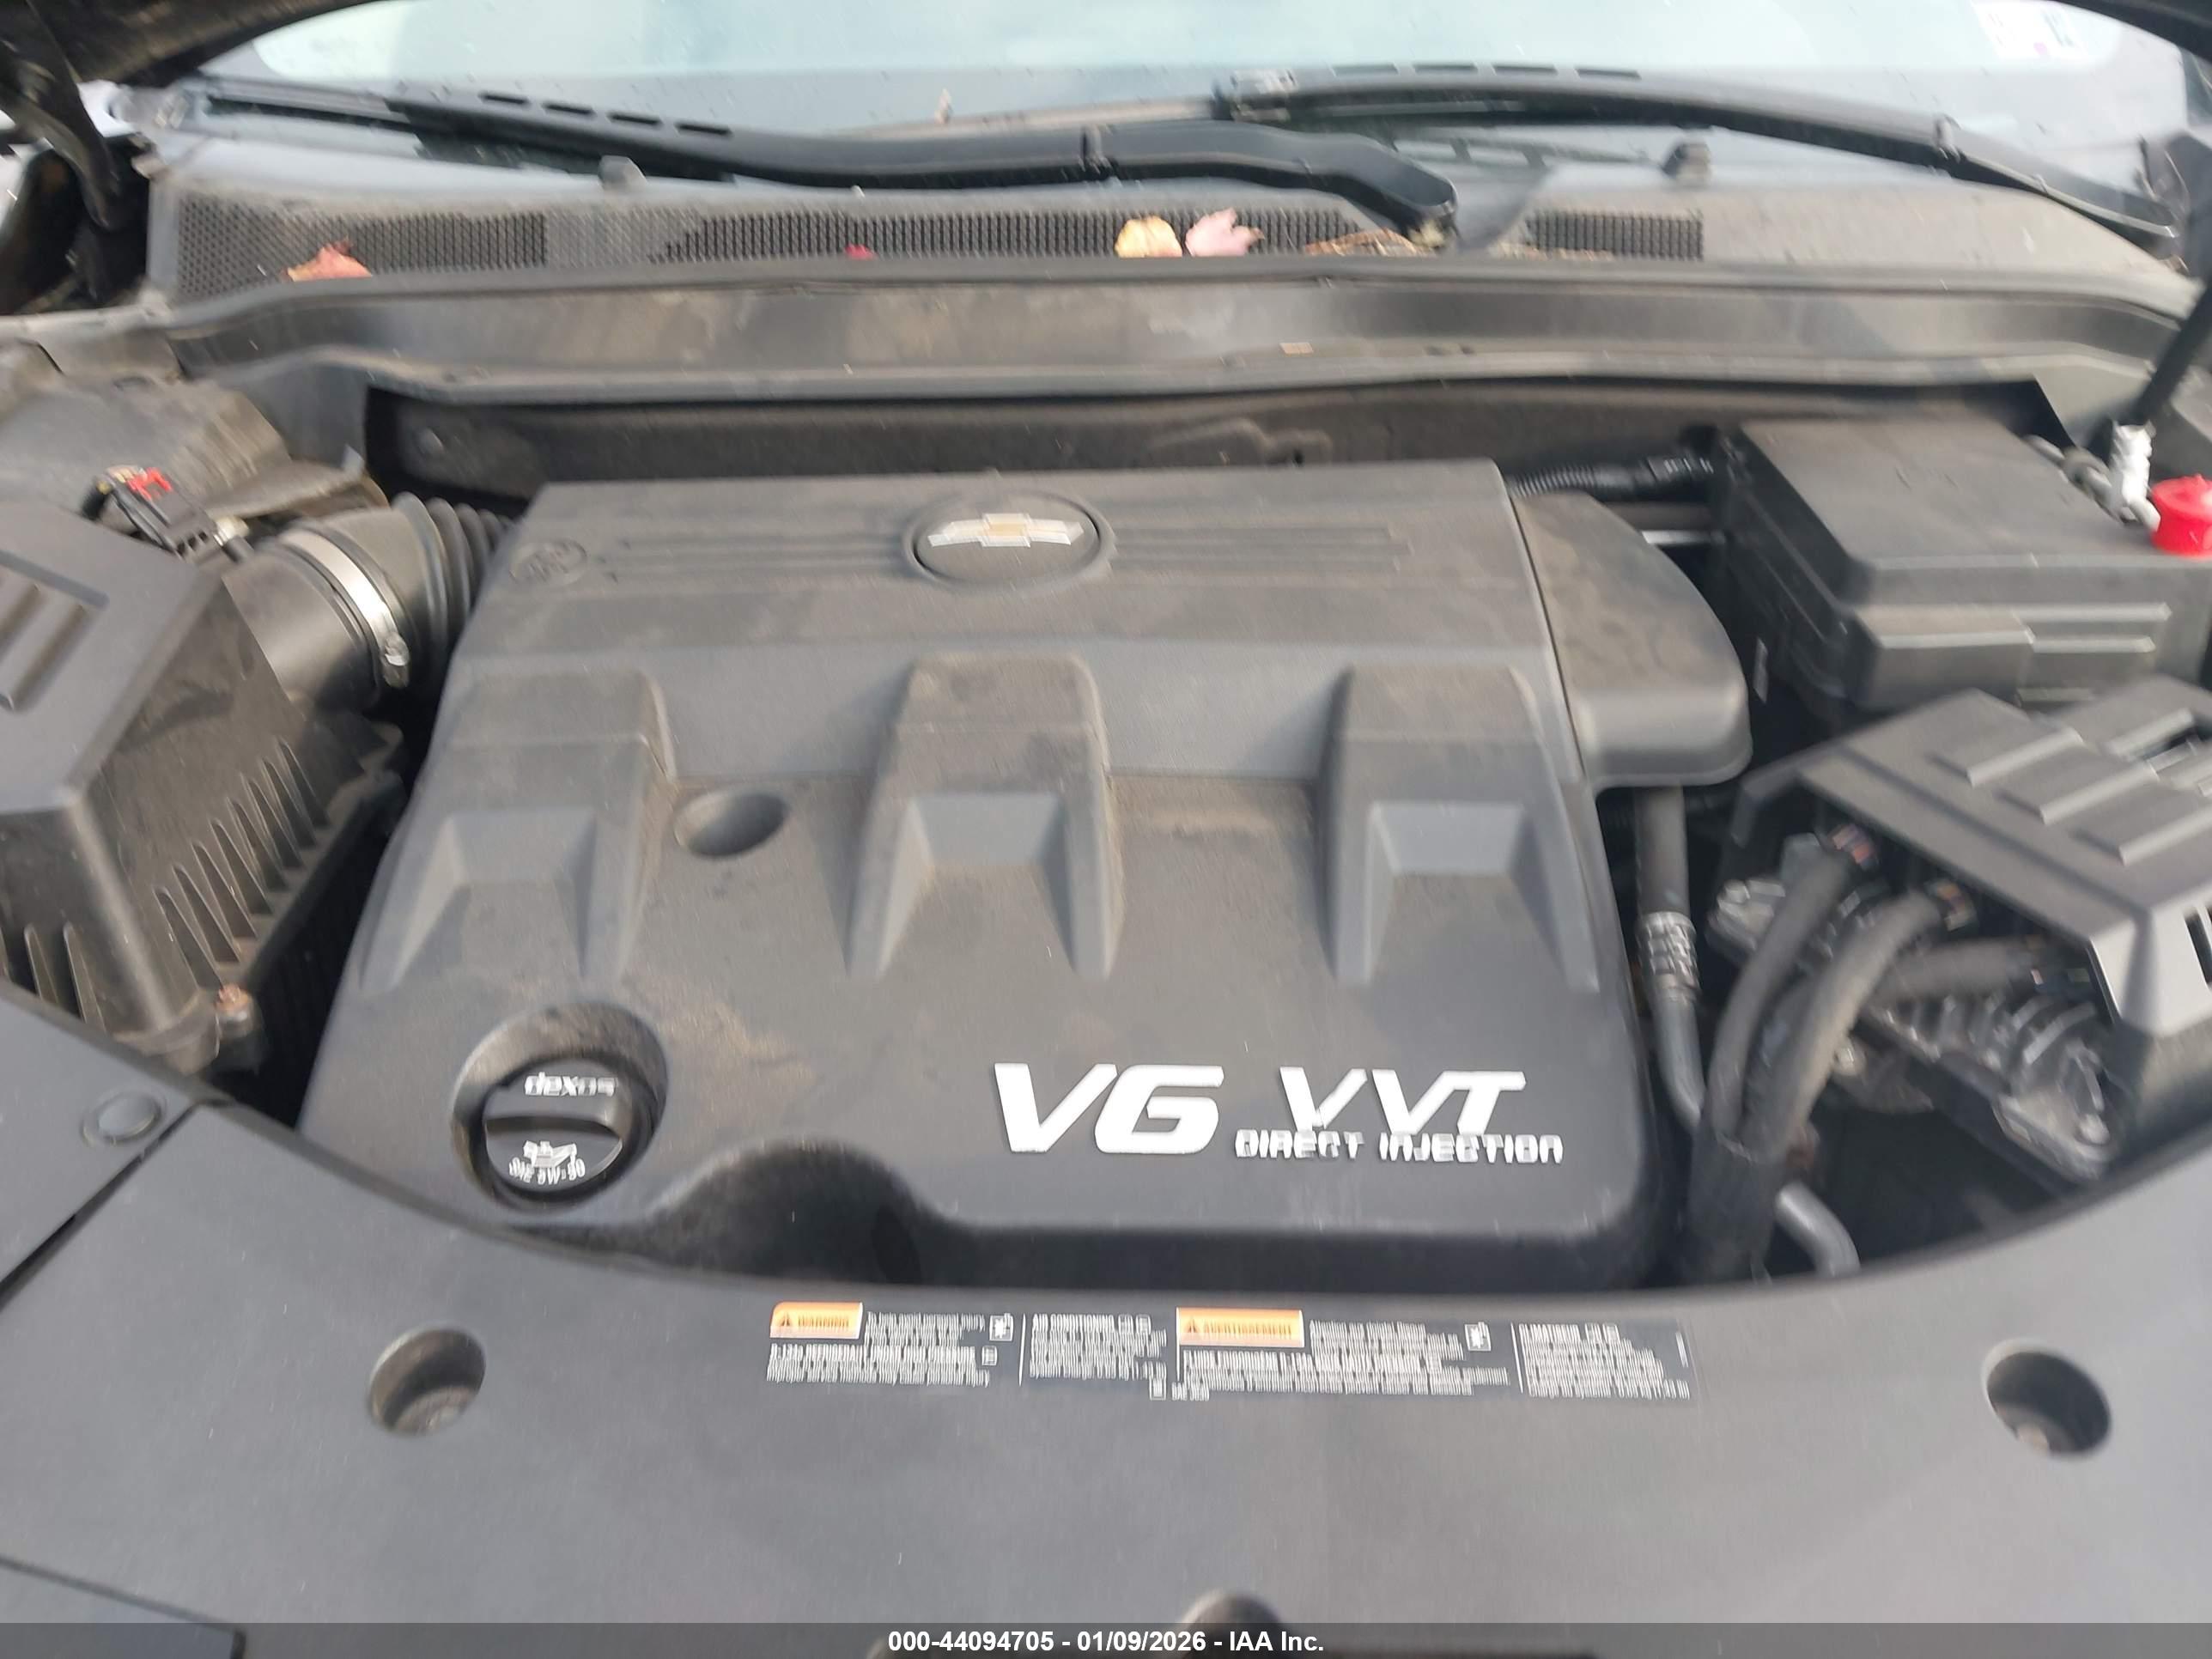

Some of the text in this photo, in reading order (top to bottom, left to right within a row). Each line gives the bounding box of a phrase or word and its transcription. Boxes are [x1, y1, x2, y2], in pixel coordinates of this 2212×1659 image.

[994, 1062, 1527, 1154] V6 VVT
[1234, 1128, 1564, 1164] DIRECT INJECTION
